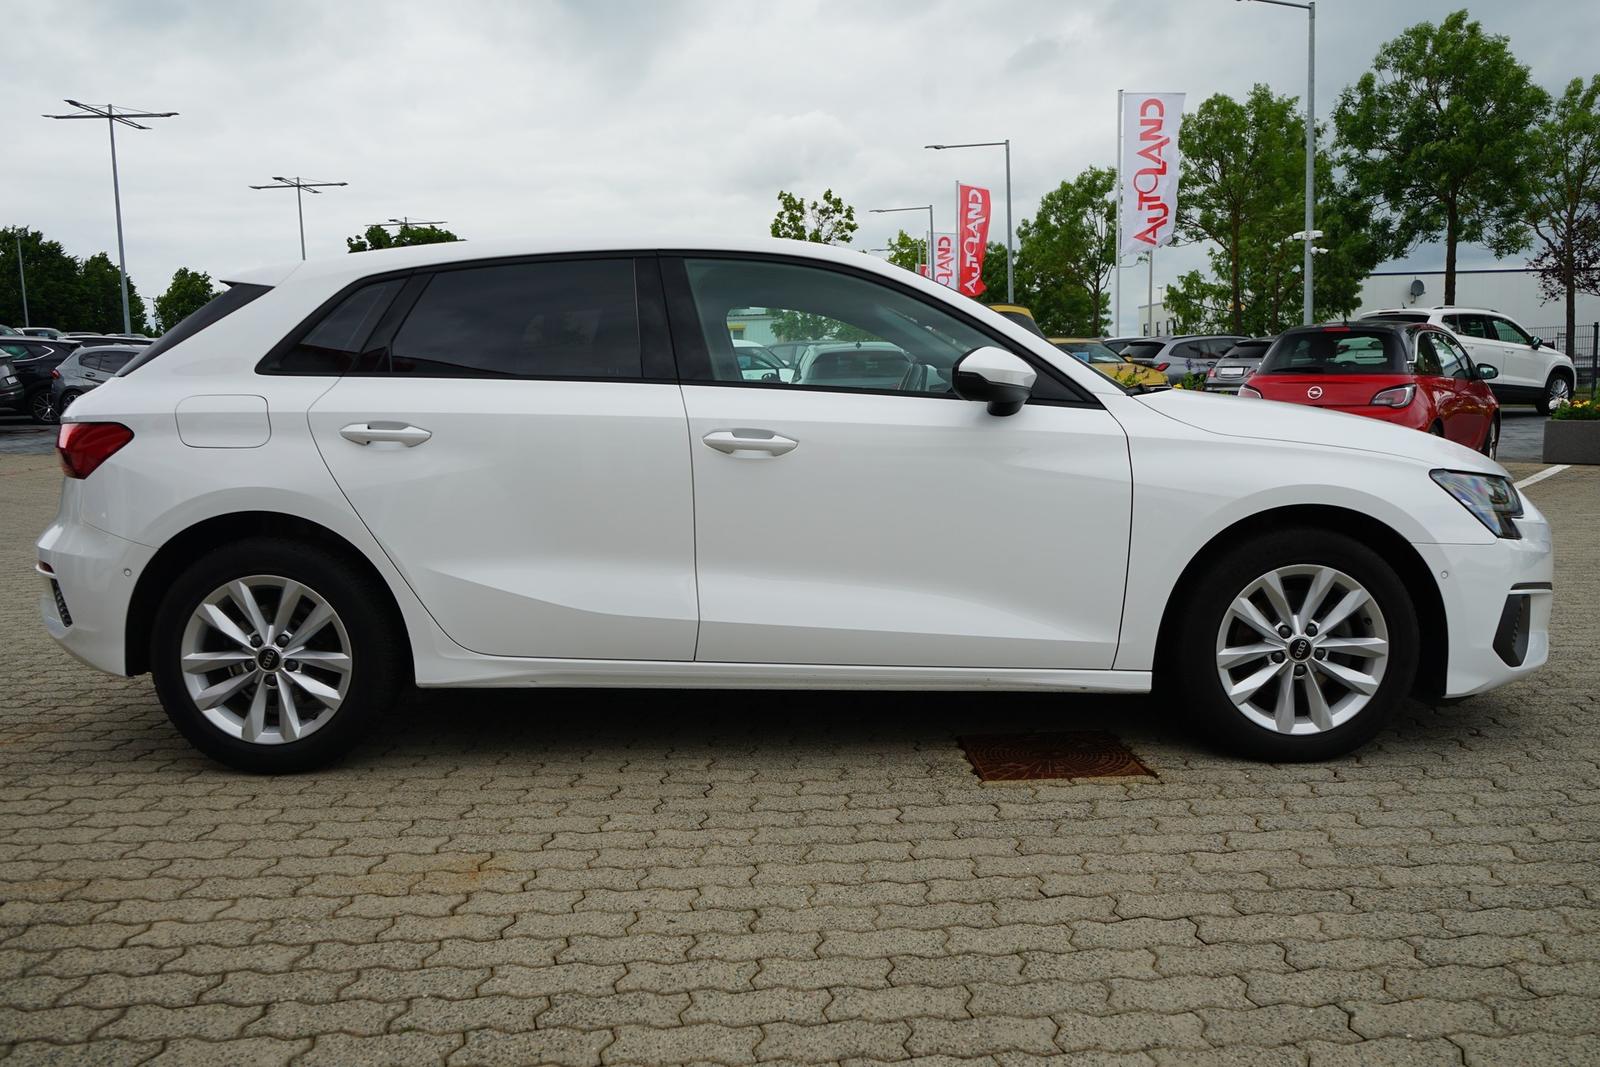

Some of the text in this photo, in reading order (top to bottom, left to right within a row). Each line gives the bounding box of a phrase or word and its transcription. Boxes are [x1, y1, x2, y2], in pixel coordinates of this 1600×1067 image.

[1133, 98, 1170, 245] AUTOLAND
[936, 236, 954, 286] OLAND
[964, 189, 986, 293] AUTOLAND
